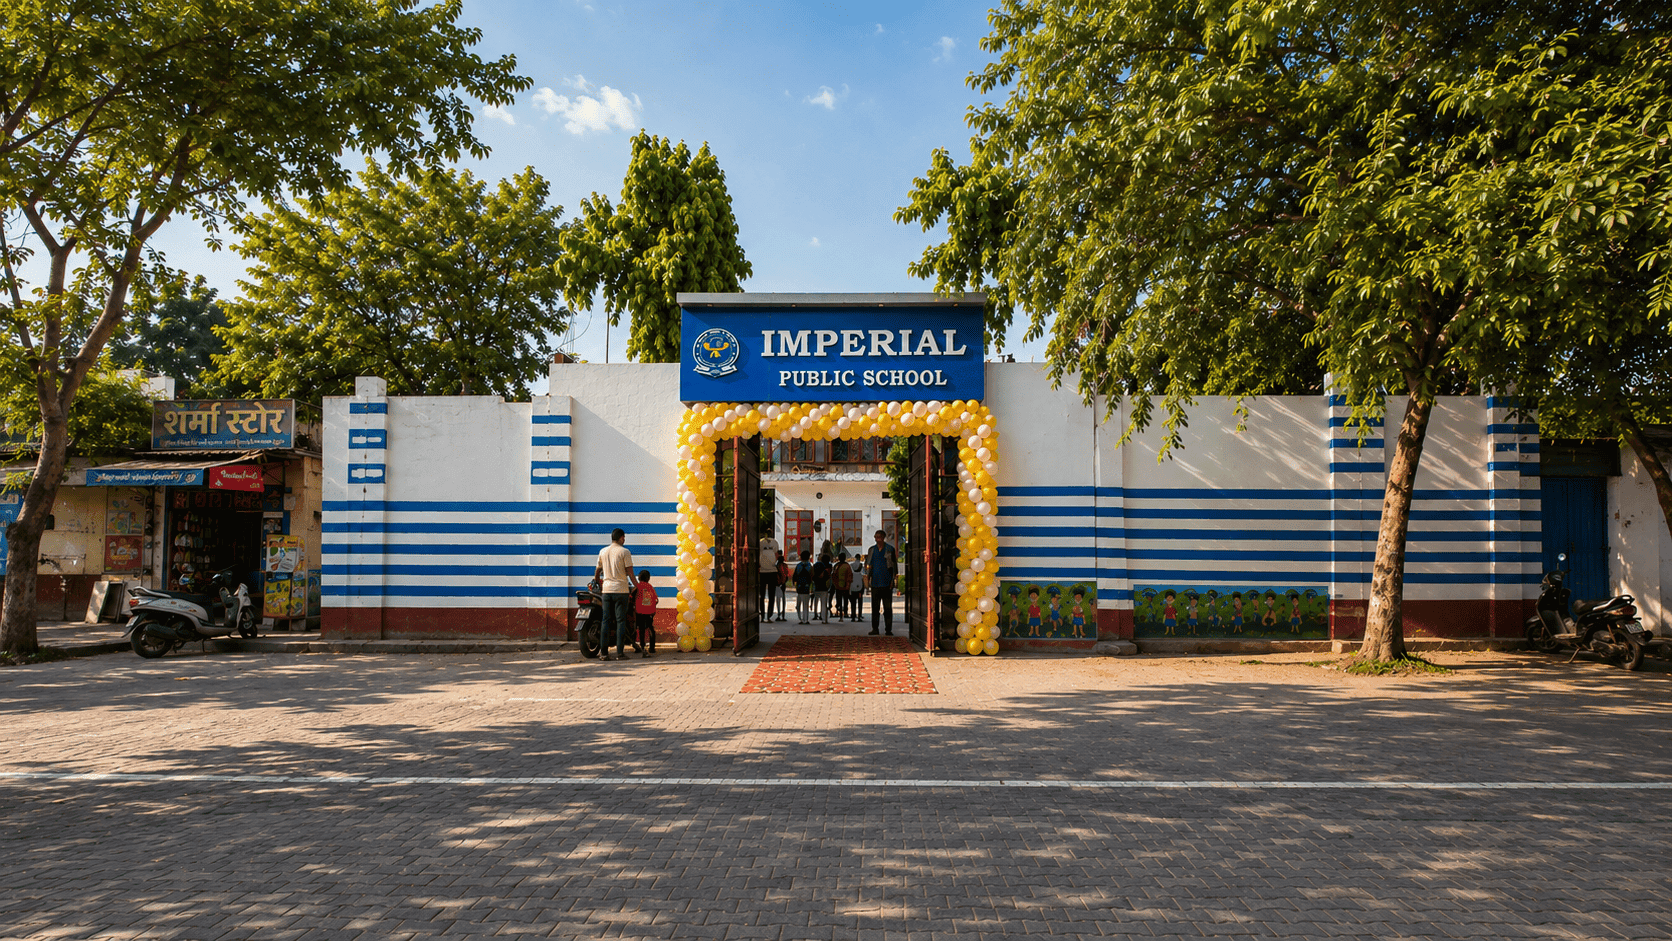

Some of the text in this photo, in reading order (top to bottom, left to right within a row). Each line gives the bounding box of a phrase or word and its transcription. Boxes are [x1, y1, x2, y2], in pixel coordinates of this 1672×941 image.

[761, 329, 967, 357] IMPERIAL
[778, 369, 948, 387] PUBLIC SCHOOL
[163, 401, 286, 435] शर्मा स्टोर
